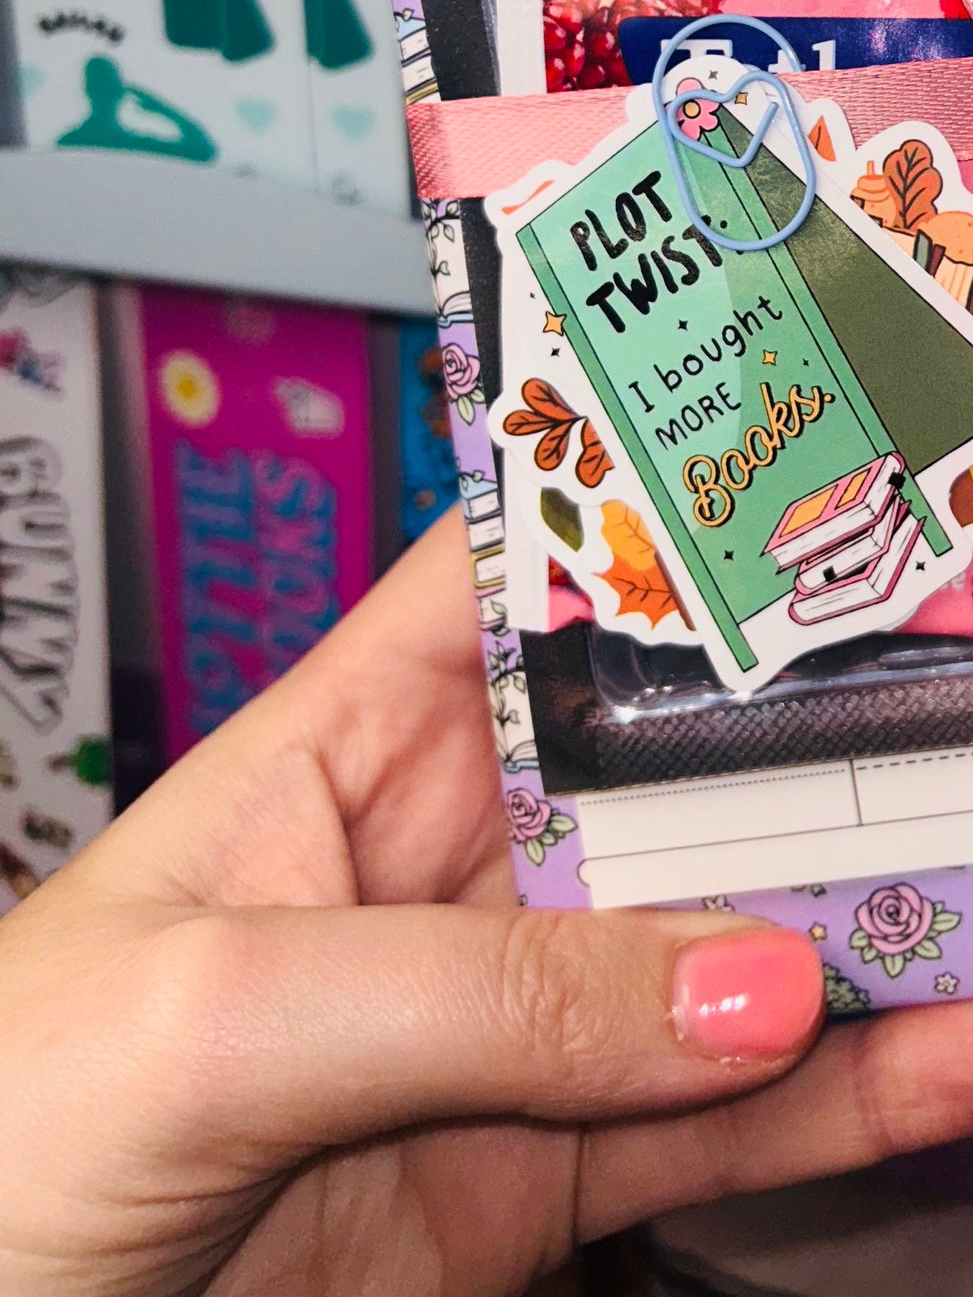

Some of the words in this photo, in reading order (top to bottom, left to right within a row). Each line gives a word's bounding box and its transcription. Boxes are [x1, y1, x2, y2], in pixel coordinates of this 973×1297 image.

[569, 170, 673, 272] PLOT
[628, 380, 655, 413] I
[653, 295, 783, 393] bought
[654, 382, 742, 450] MORE
[682, 382, 836, 528] Books.
